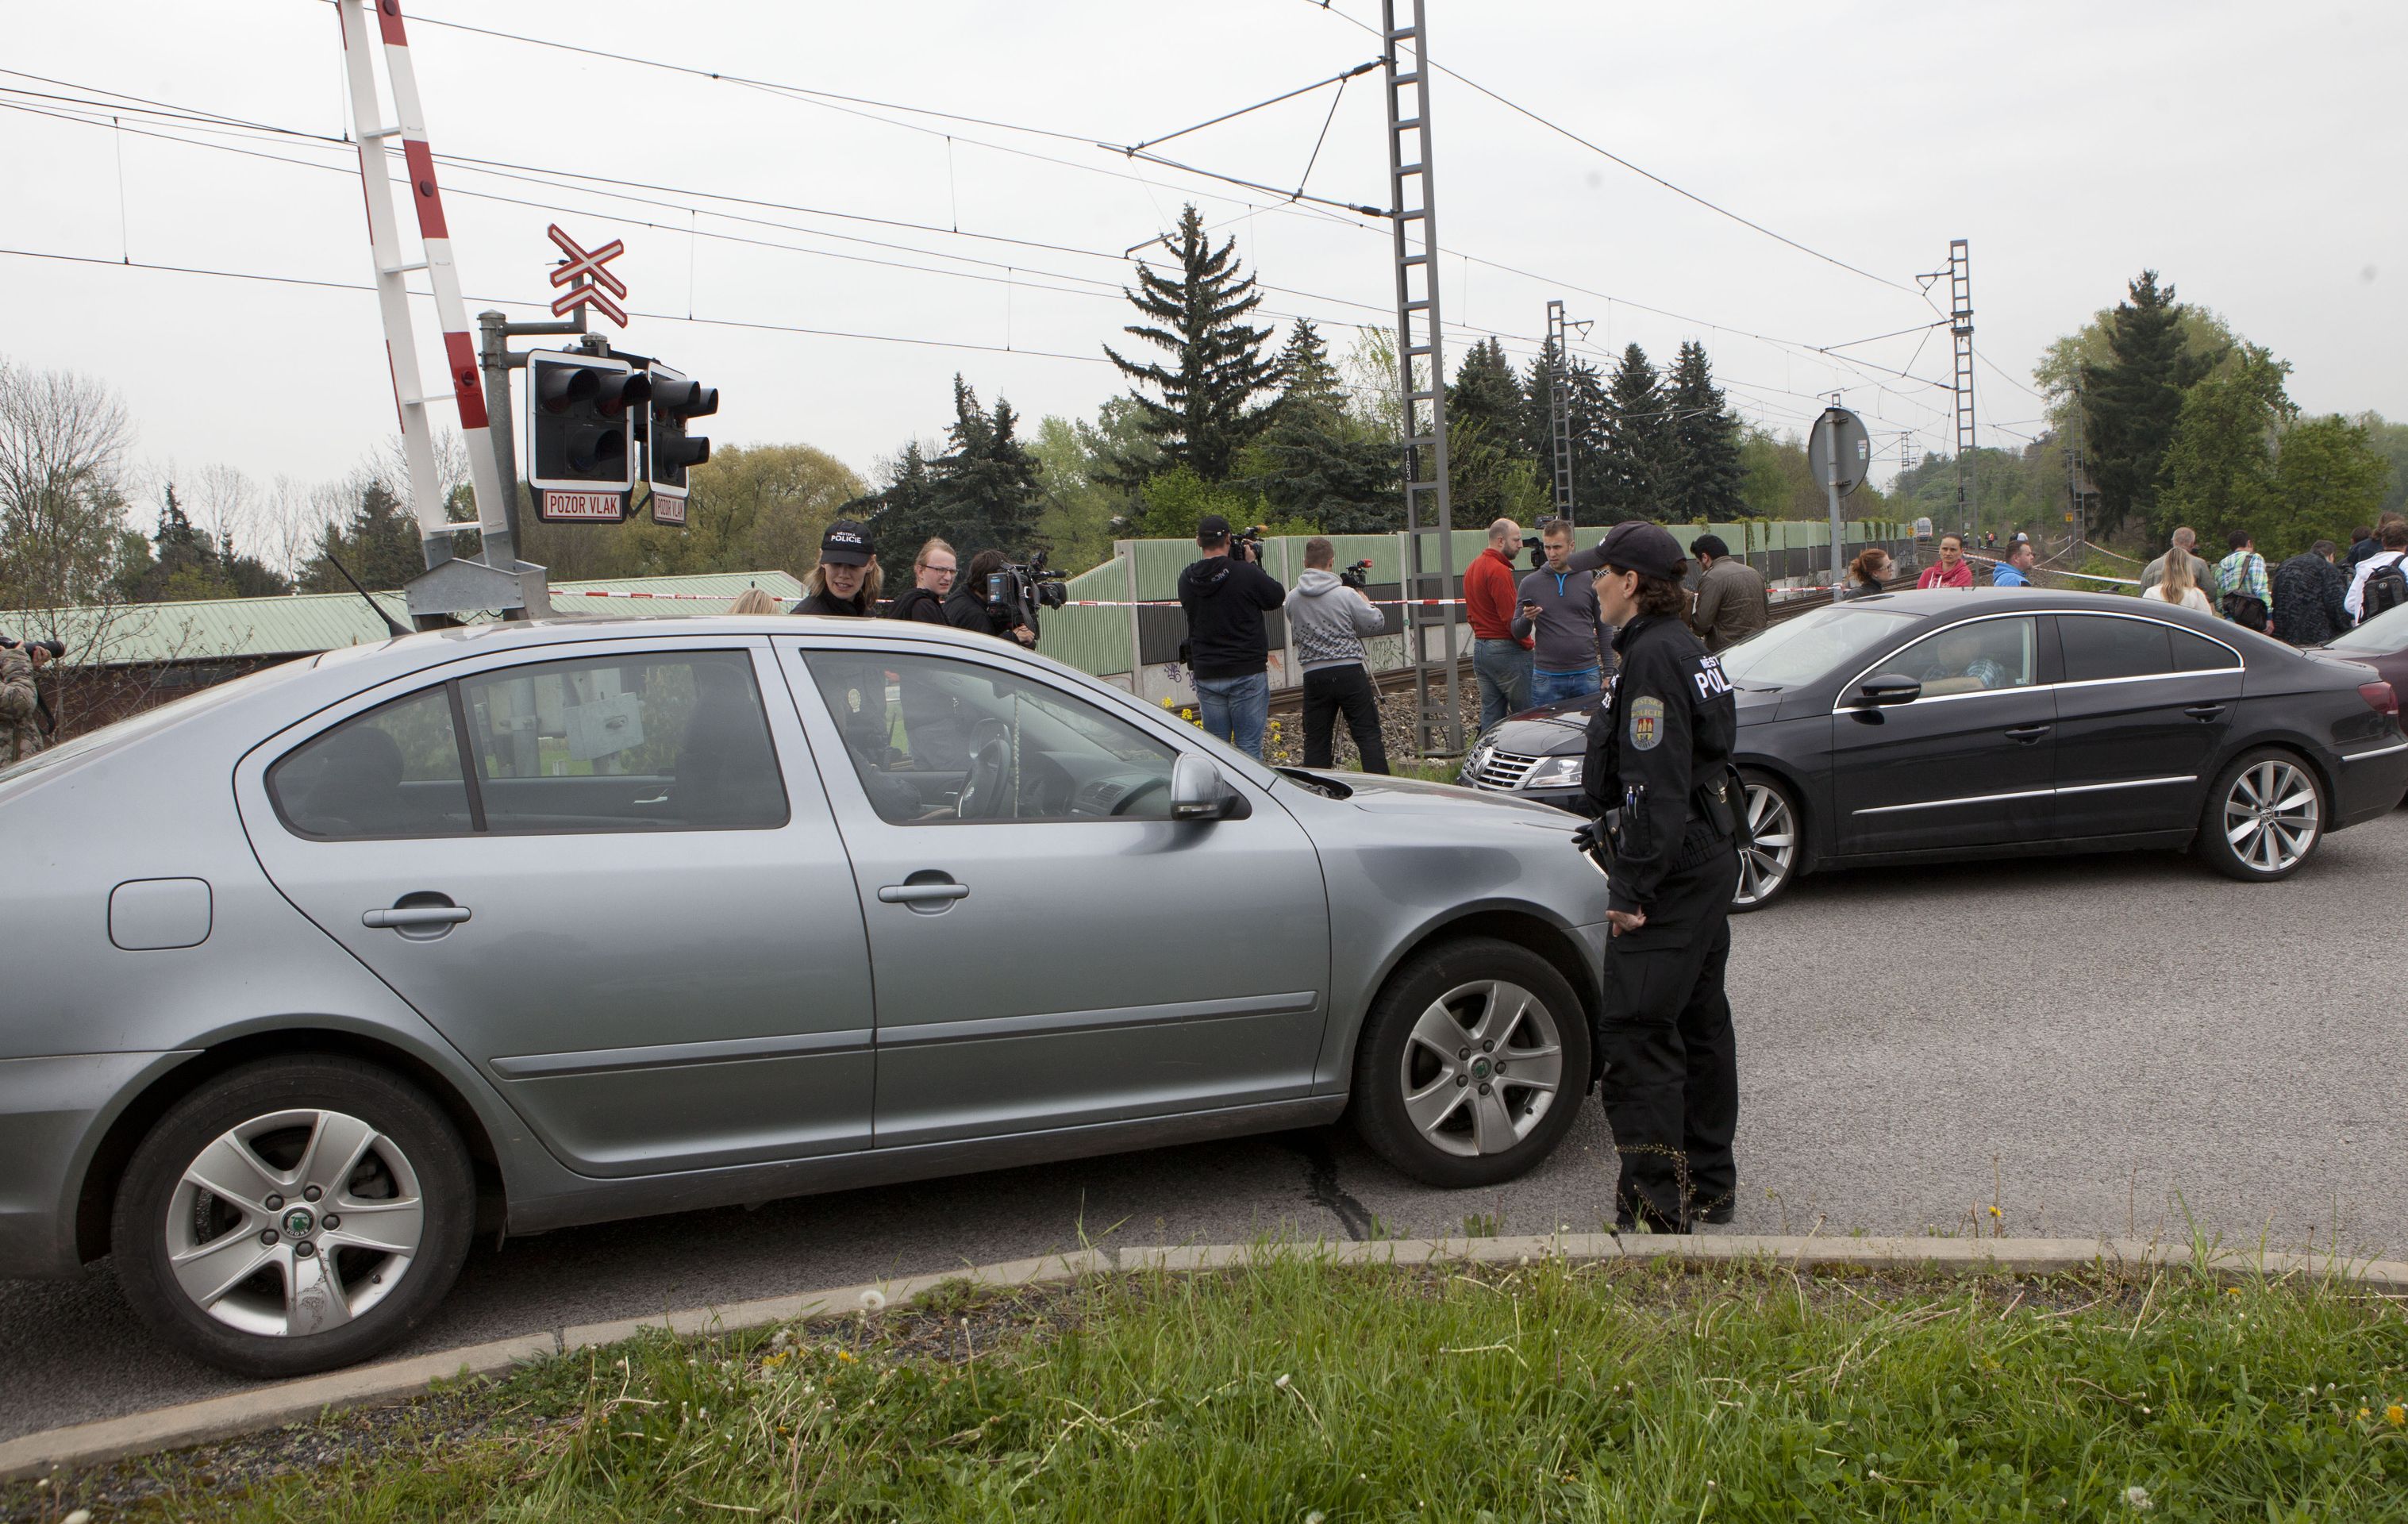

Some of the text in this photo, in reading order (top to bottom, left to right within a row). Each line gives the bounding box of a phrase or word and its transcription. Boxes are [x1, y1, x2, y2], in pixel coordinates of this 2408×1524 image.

[550, 495, 617, 514] POZOR VLAK
[657, 498, 683, 518] POZOR VLAK
[830, 535, 862, 544] POLICIE
[1694, 668, 1733, 698] POL
